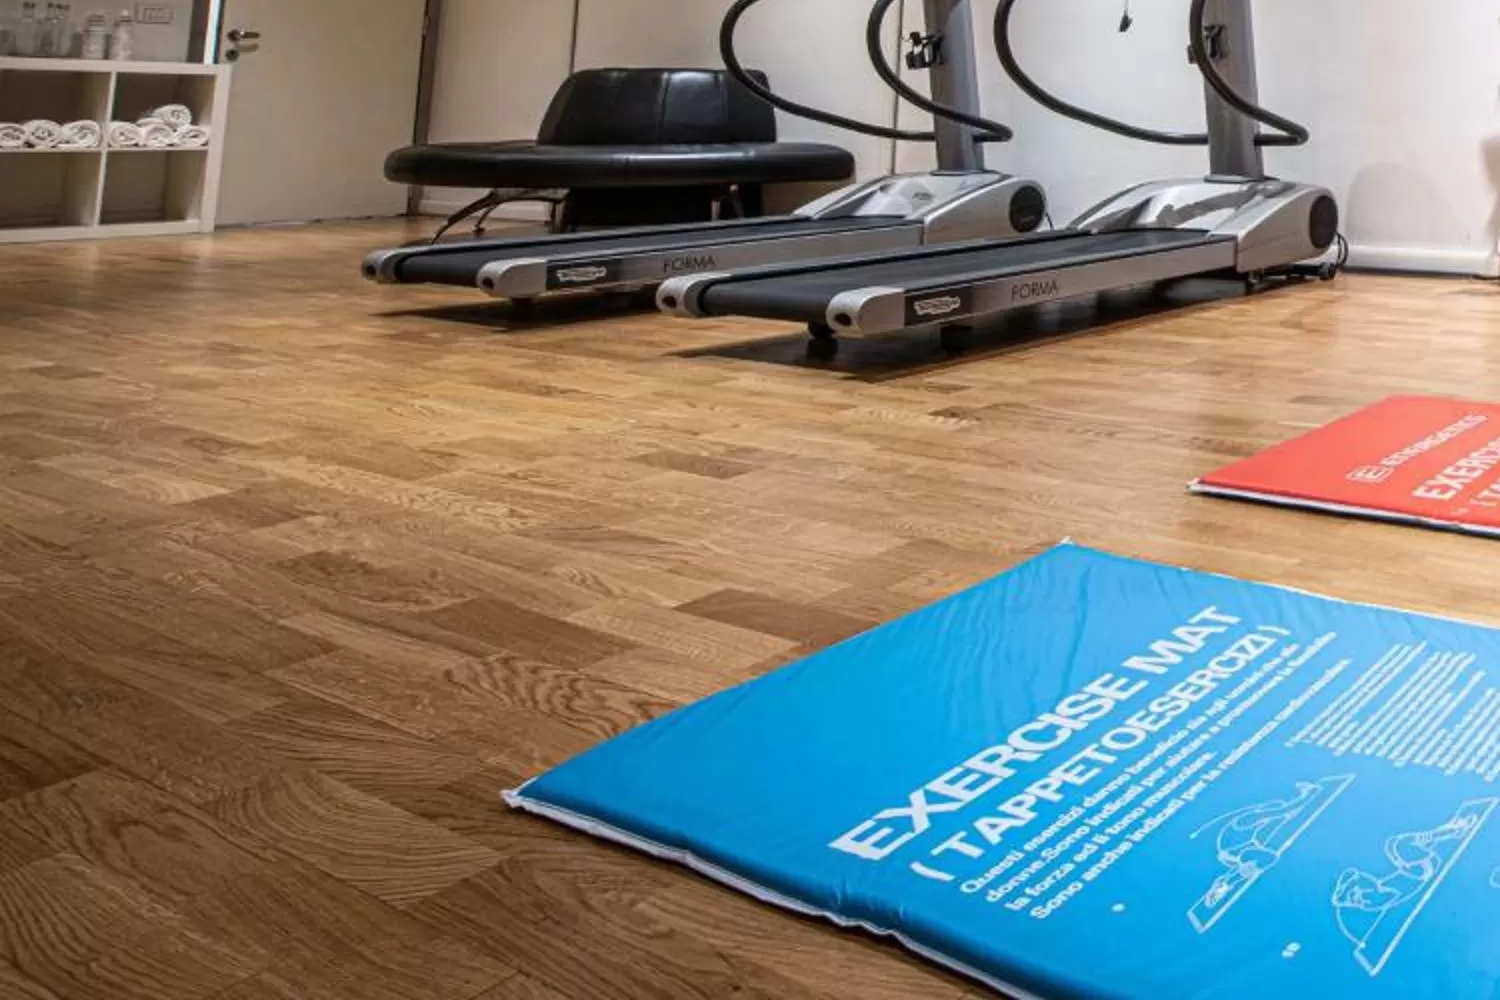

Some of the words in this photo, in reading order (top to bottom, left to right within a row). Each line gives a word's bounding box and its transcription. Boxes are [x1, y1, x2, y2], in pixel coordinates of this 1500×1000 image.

[663, 255, 716, 273] FORMA
[1011, 279, 1060, 301] FORMA
[828, 672, 1149, 861] EXERCISE
[1121, 605, 1241, 675] MAT
[960, 849, 1025, 892] Questi
[1024, 861, 1076, 896] forza
[1104, 805, 1147, 835] tono
[1030, 880, 1083, 919] Sono
[1081, 839, 1133, 882] anche
